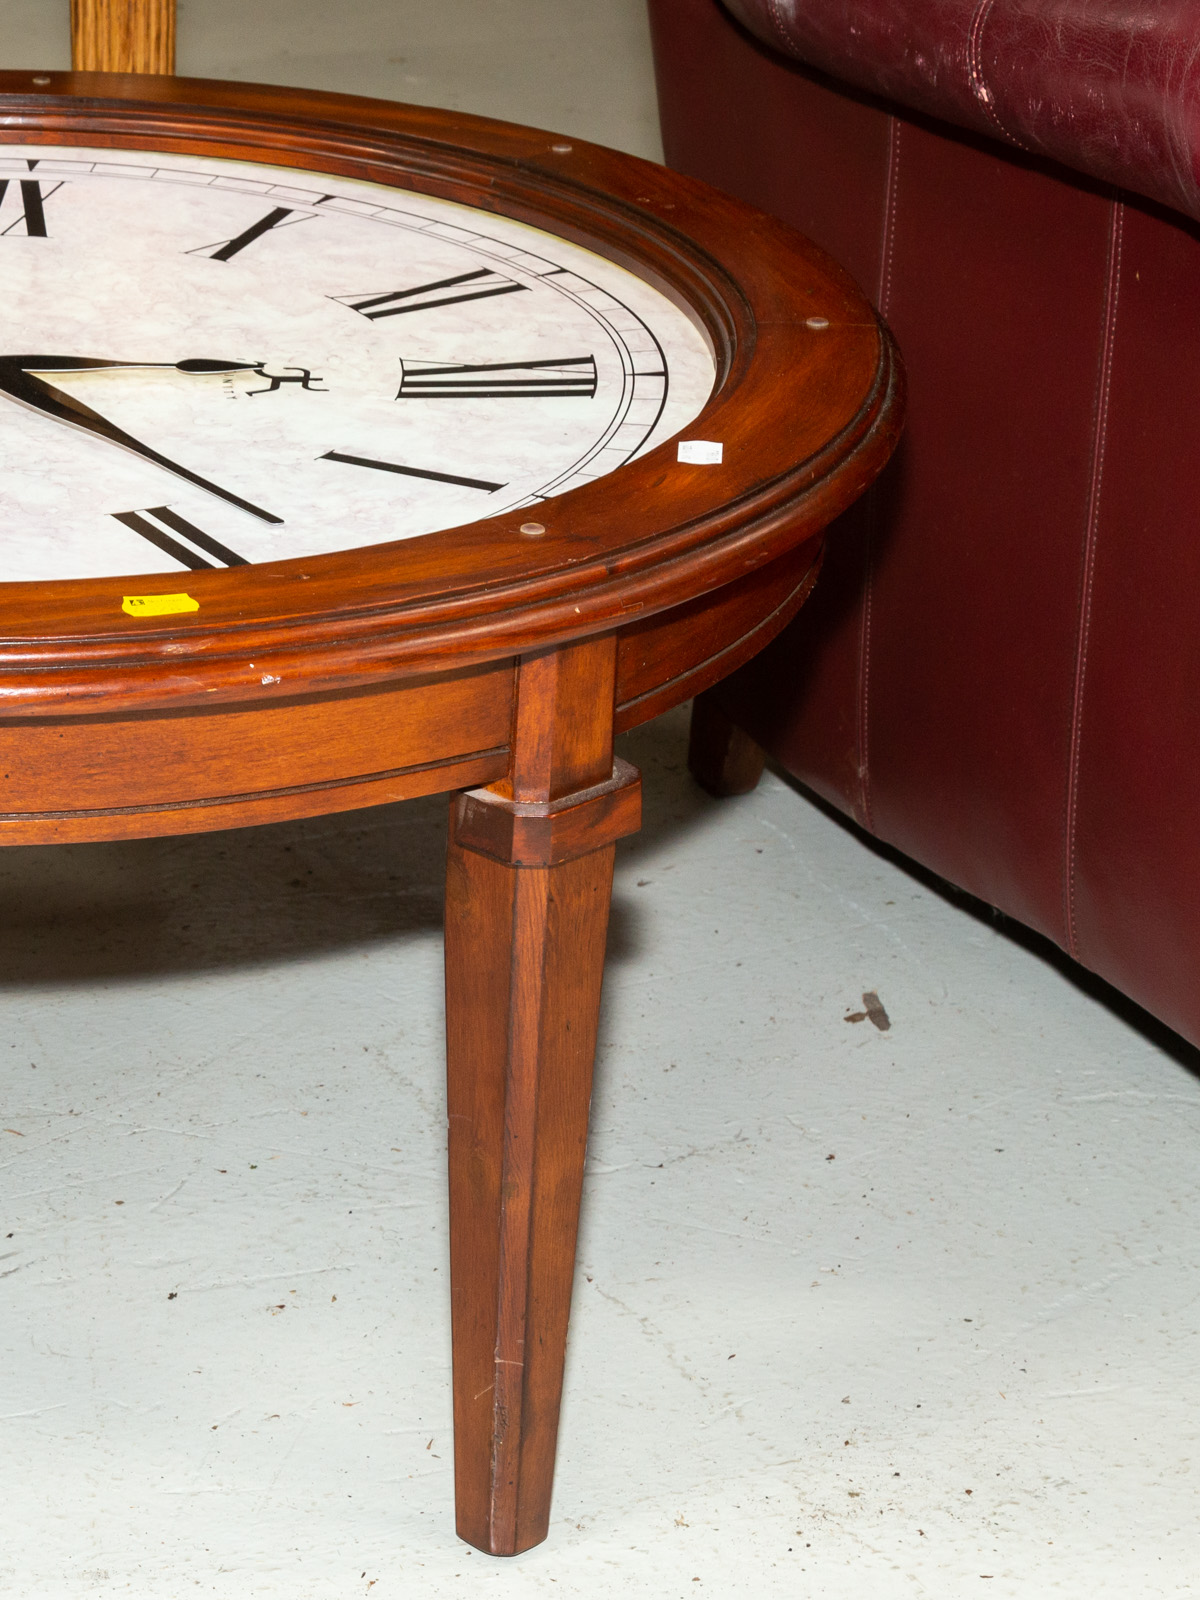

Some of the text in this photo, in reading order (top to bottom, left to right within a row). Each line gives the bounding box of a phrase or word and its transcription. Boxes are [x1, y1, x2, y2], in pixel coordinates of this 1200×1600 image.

[180, 206, 326, 262] X
[325, 266, 533, 321] XI
[395, 353, 598, 400] XII
[315, 450, 510, 494] I
[104, 504, 249, 570] II
